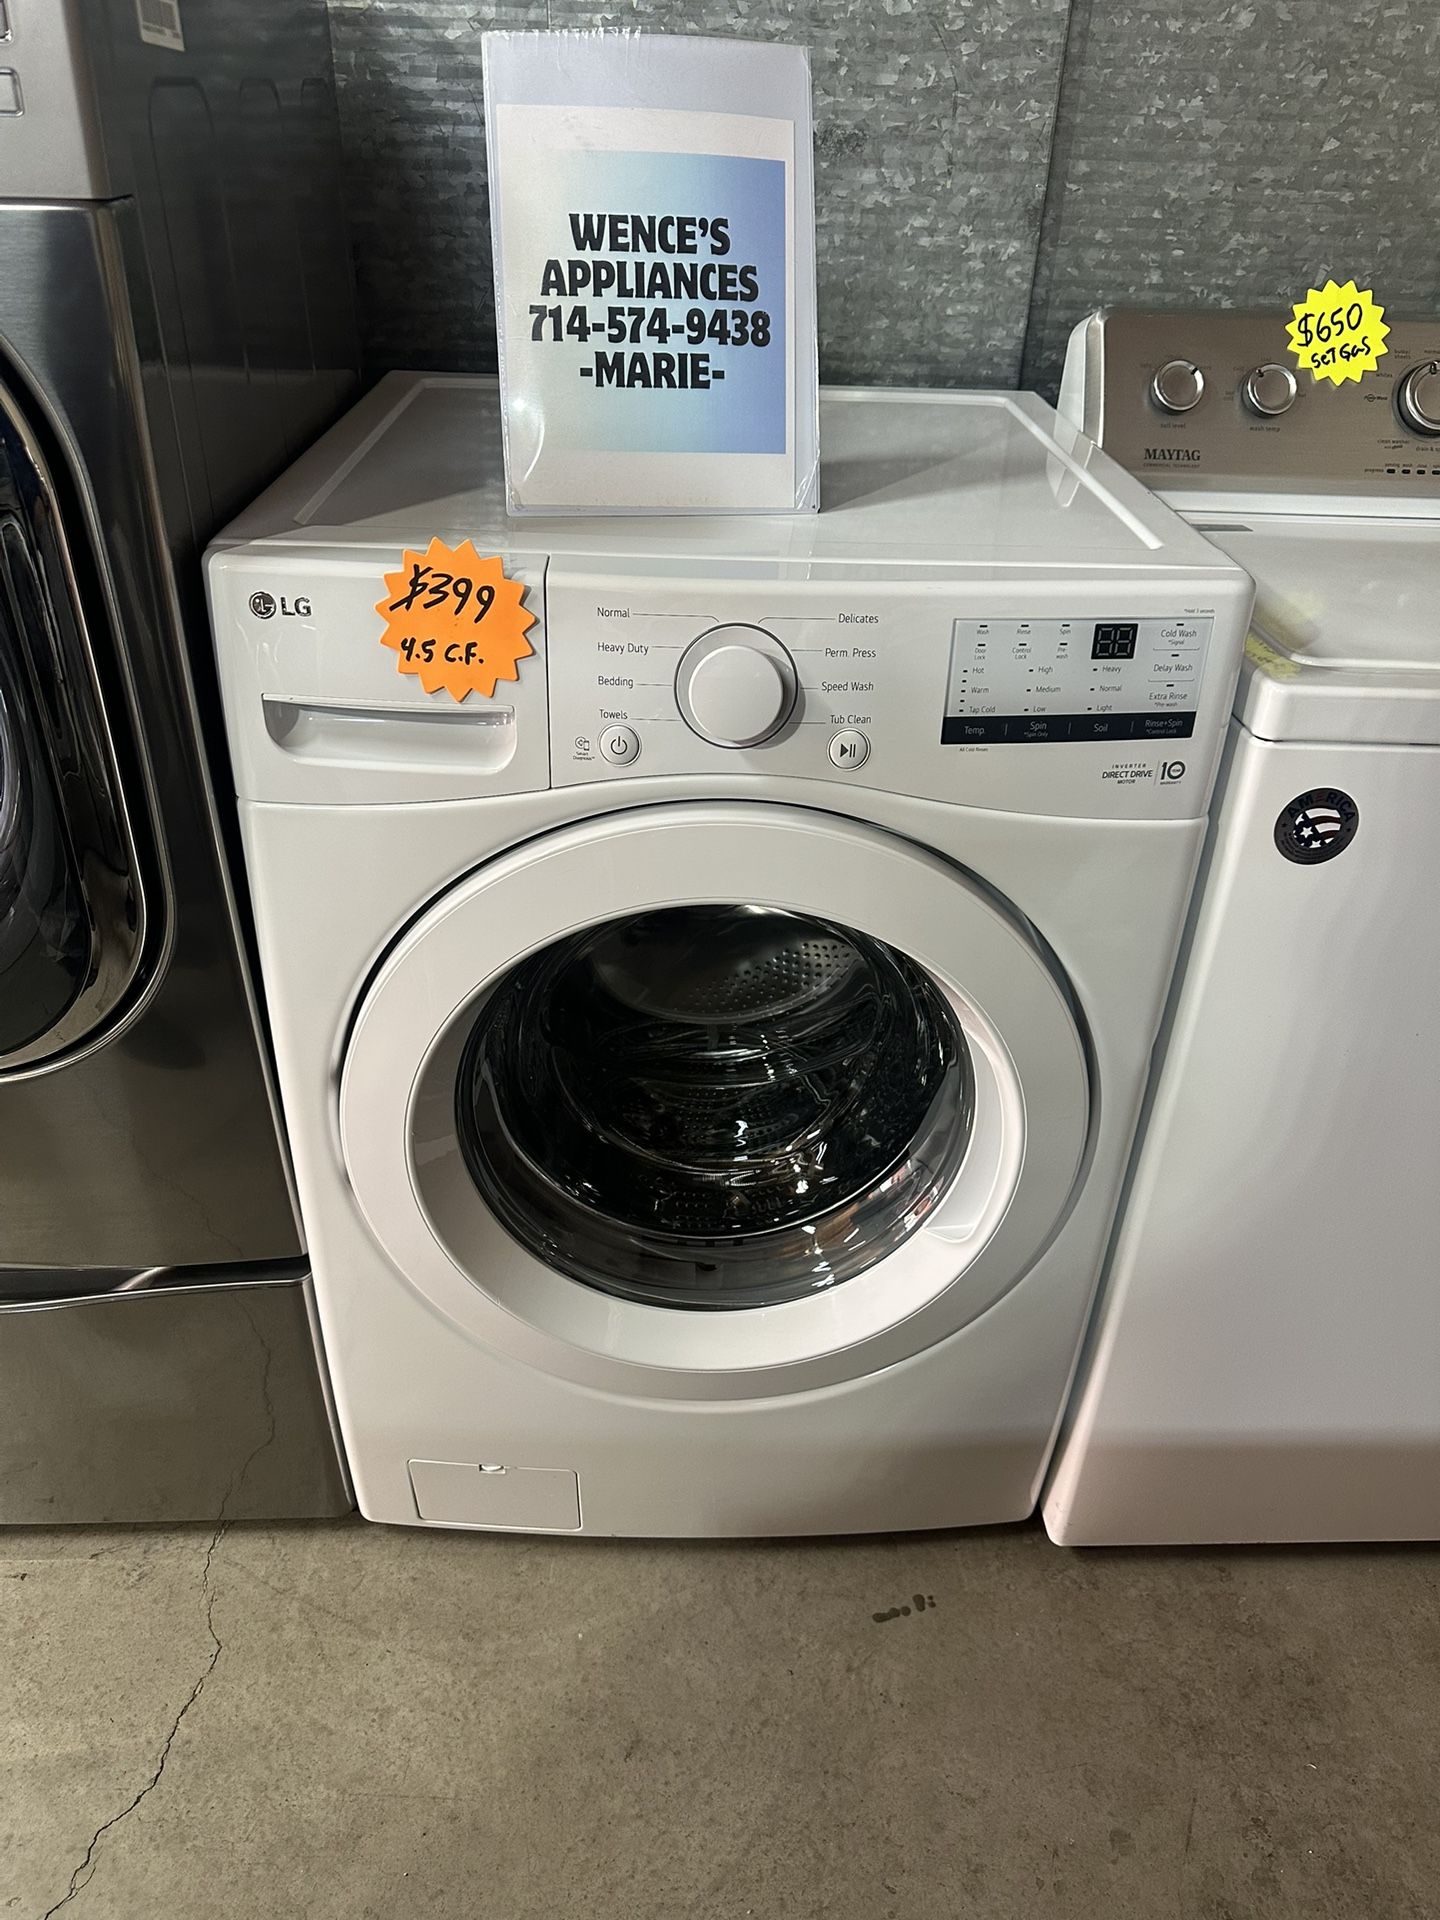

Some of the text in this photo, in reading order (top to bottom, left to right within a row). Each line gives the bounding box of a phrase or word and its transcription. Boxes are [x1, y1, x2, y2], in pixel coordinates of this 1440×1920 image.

[568, 213, 731, 256] WENCE'S
[540, 259, 759, 302] APPLIANCES
[529, 304, 771, 347] 714-574-9438
[1297, 303, 1363, 347] $650
[579, 351, 725, 389] -MARIE-
[1144, 448, 1200, 461] MAYTAG
[389, 564, 495, 623] $399
[280, 596, 311, 617] LG
[597, 606, 630, 619] Normal
[838, 613, 879, 624] Delicates
[1160, 629, 1197, 638] Cold Wash
[400, 637, 494, 665] 4.5 C.F.
[597, 642, 649, 656] Heavy Duty
[852, 648, 876, 658] Press
[1038, 666, 1053, 674] High
[1153, 663, 1193, 673] Delay Wash
[598, 676, 634, 689] Bedding
[821, 681, 874, 693] Speed Wash
[1149, 692, 1187, 700] Extra Rinse
[599, 709, 628, 720] Towels
[830, 714, 872, 725] Tub Clean
[1030, 721, 1047, 731] Spin
[1093, 723, 1108, 732] Soil
[1145, 719, 1183, 728] Rinse+Spin
[1102, 770, 1153, 779] DIRECT DRIVE
[1161, 761, 1185, 780] 10
